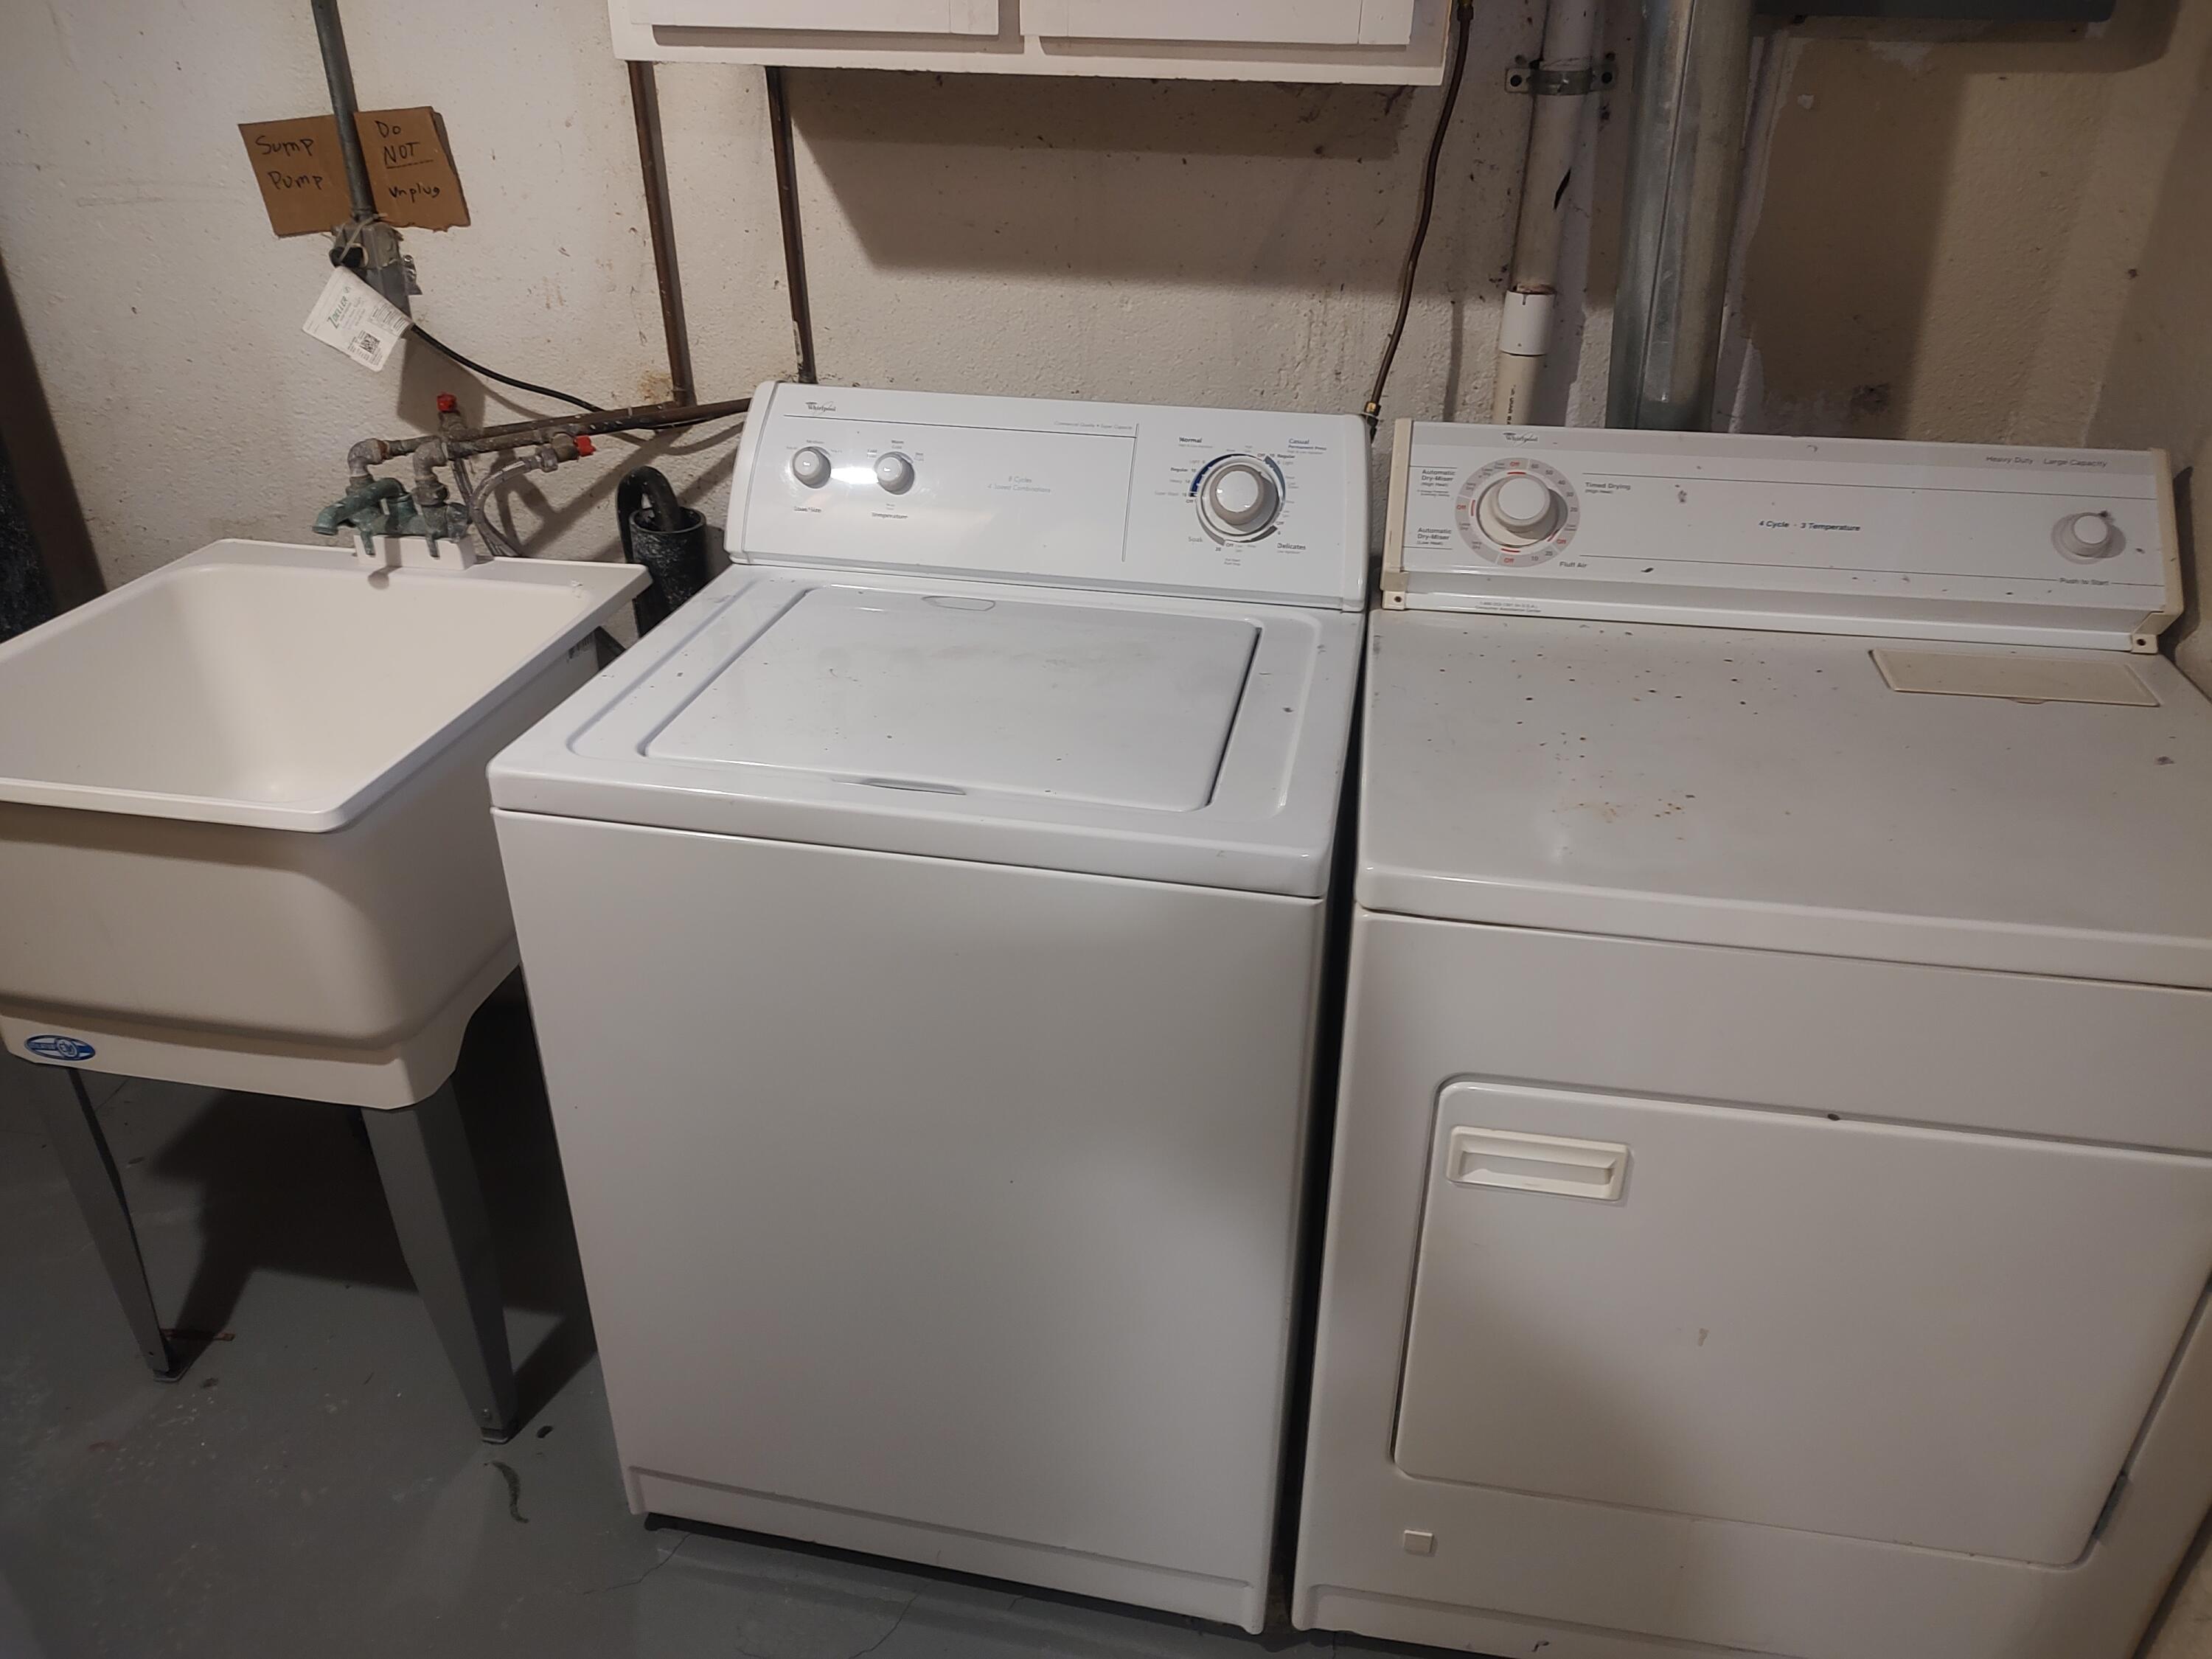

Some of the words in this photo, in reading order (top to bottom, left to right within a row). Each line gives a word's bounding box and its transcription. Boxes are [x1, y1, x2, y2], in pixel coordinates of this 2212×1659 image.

[375, 120, 402, 138] Do
[255, 135, 315, 157] Sump
[383, 142, 420, 165] NOT
[268, 170, 324, 190] Pump
[805, 401, 837, 414] Whirlpool
[1503, 432, 1539, 445] Whirlpool
[1986, 456, 2013, 464] Heavy
[2014, 456, 2034, 465] Duty
[2043, 459, 2067, 467] Large
[2070, 459, 2107, 468] Capacity
[1608, 483, 1632, 491] Drying
[1766, 521, 1790, 529] Cycle
[1808, 523, 1861, 532] Temperature
[1277, 543, 1307, 551] Delicates
